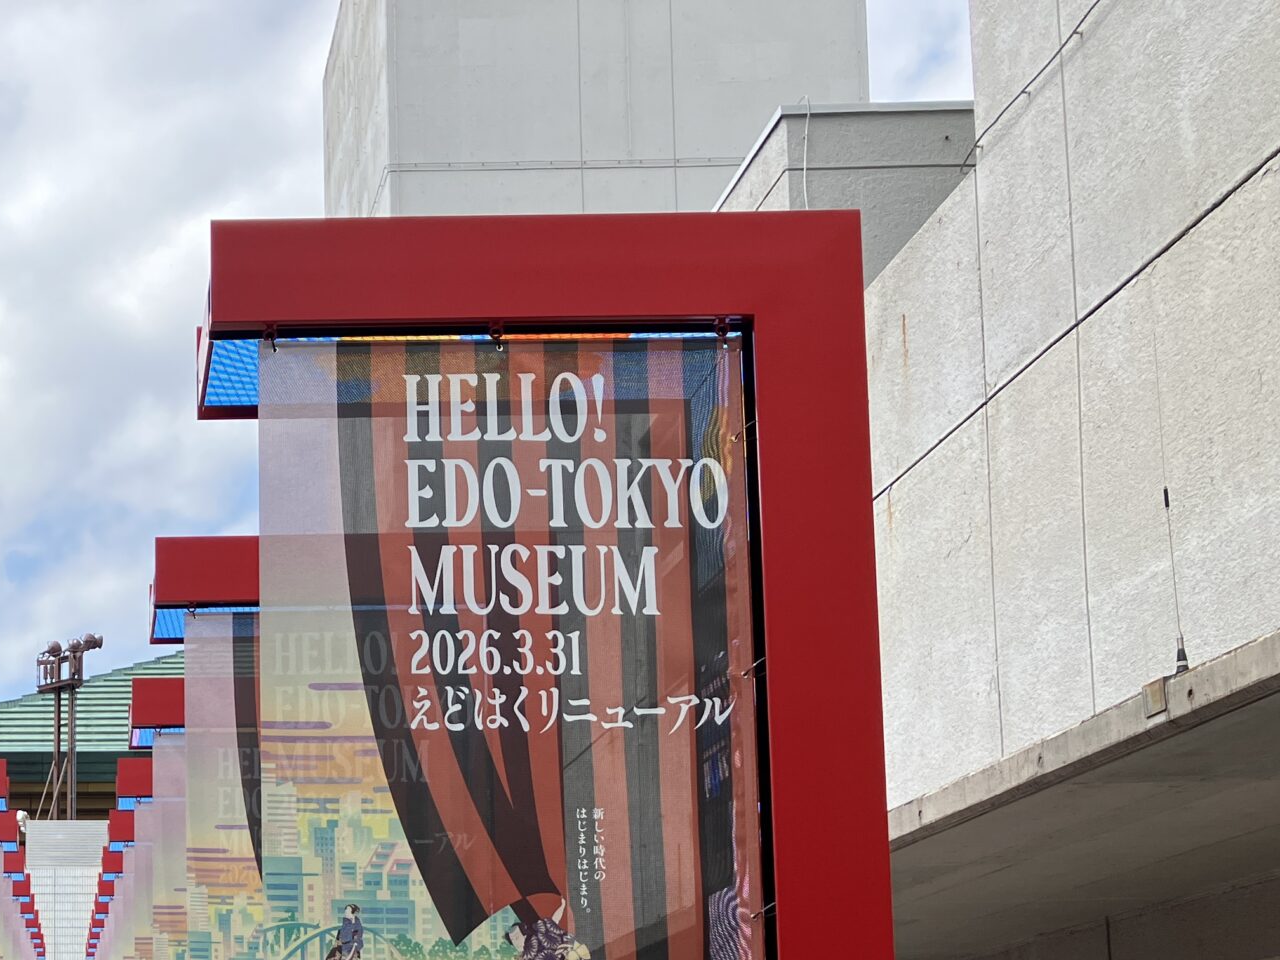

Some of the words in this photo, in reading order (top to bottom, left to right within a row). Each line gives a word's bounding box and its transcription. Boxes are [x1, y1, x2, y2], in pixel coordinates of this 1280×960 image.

[403, 372, 607, 443] HELLO!
[404, 456, 729, 529] EDO-TOKYO
[407, 544, 661, 616] MUSEUM
[410, 629, 583, 677] 2026.3.31
[410, 687, 737, 735] えどはくリニューアル
[576, 807, 591, 913] はじまりはじまり。
[592, 807, 606, 881] 新しい時代の
